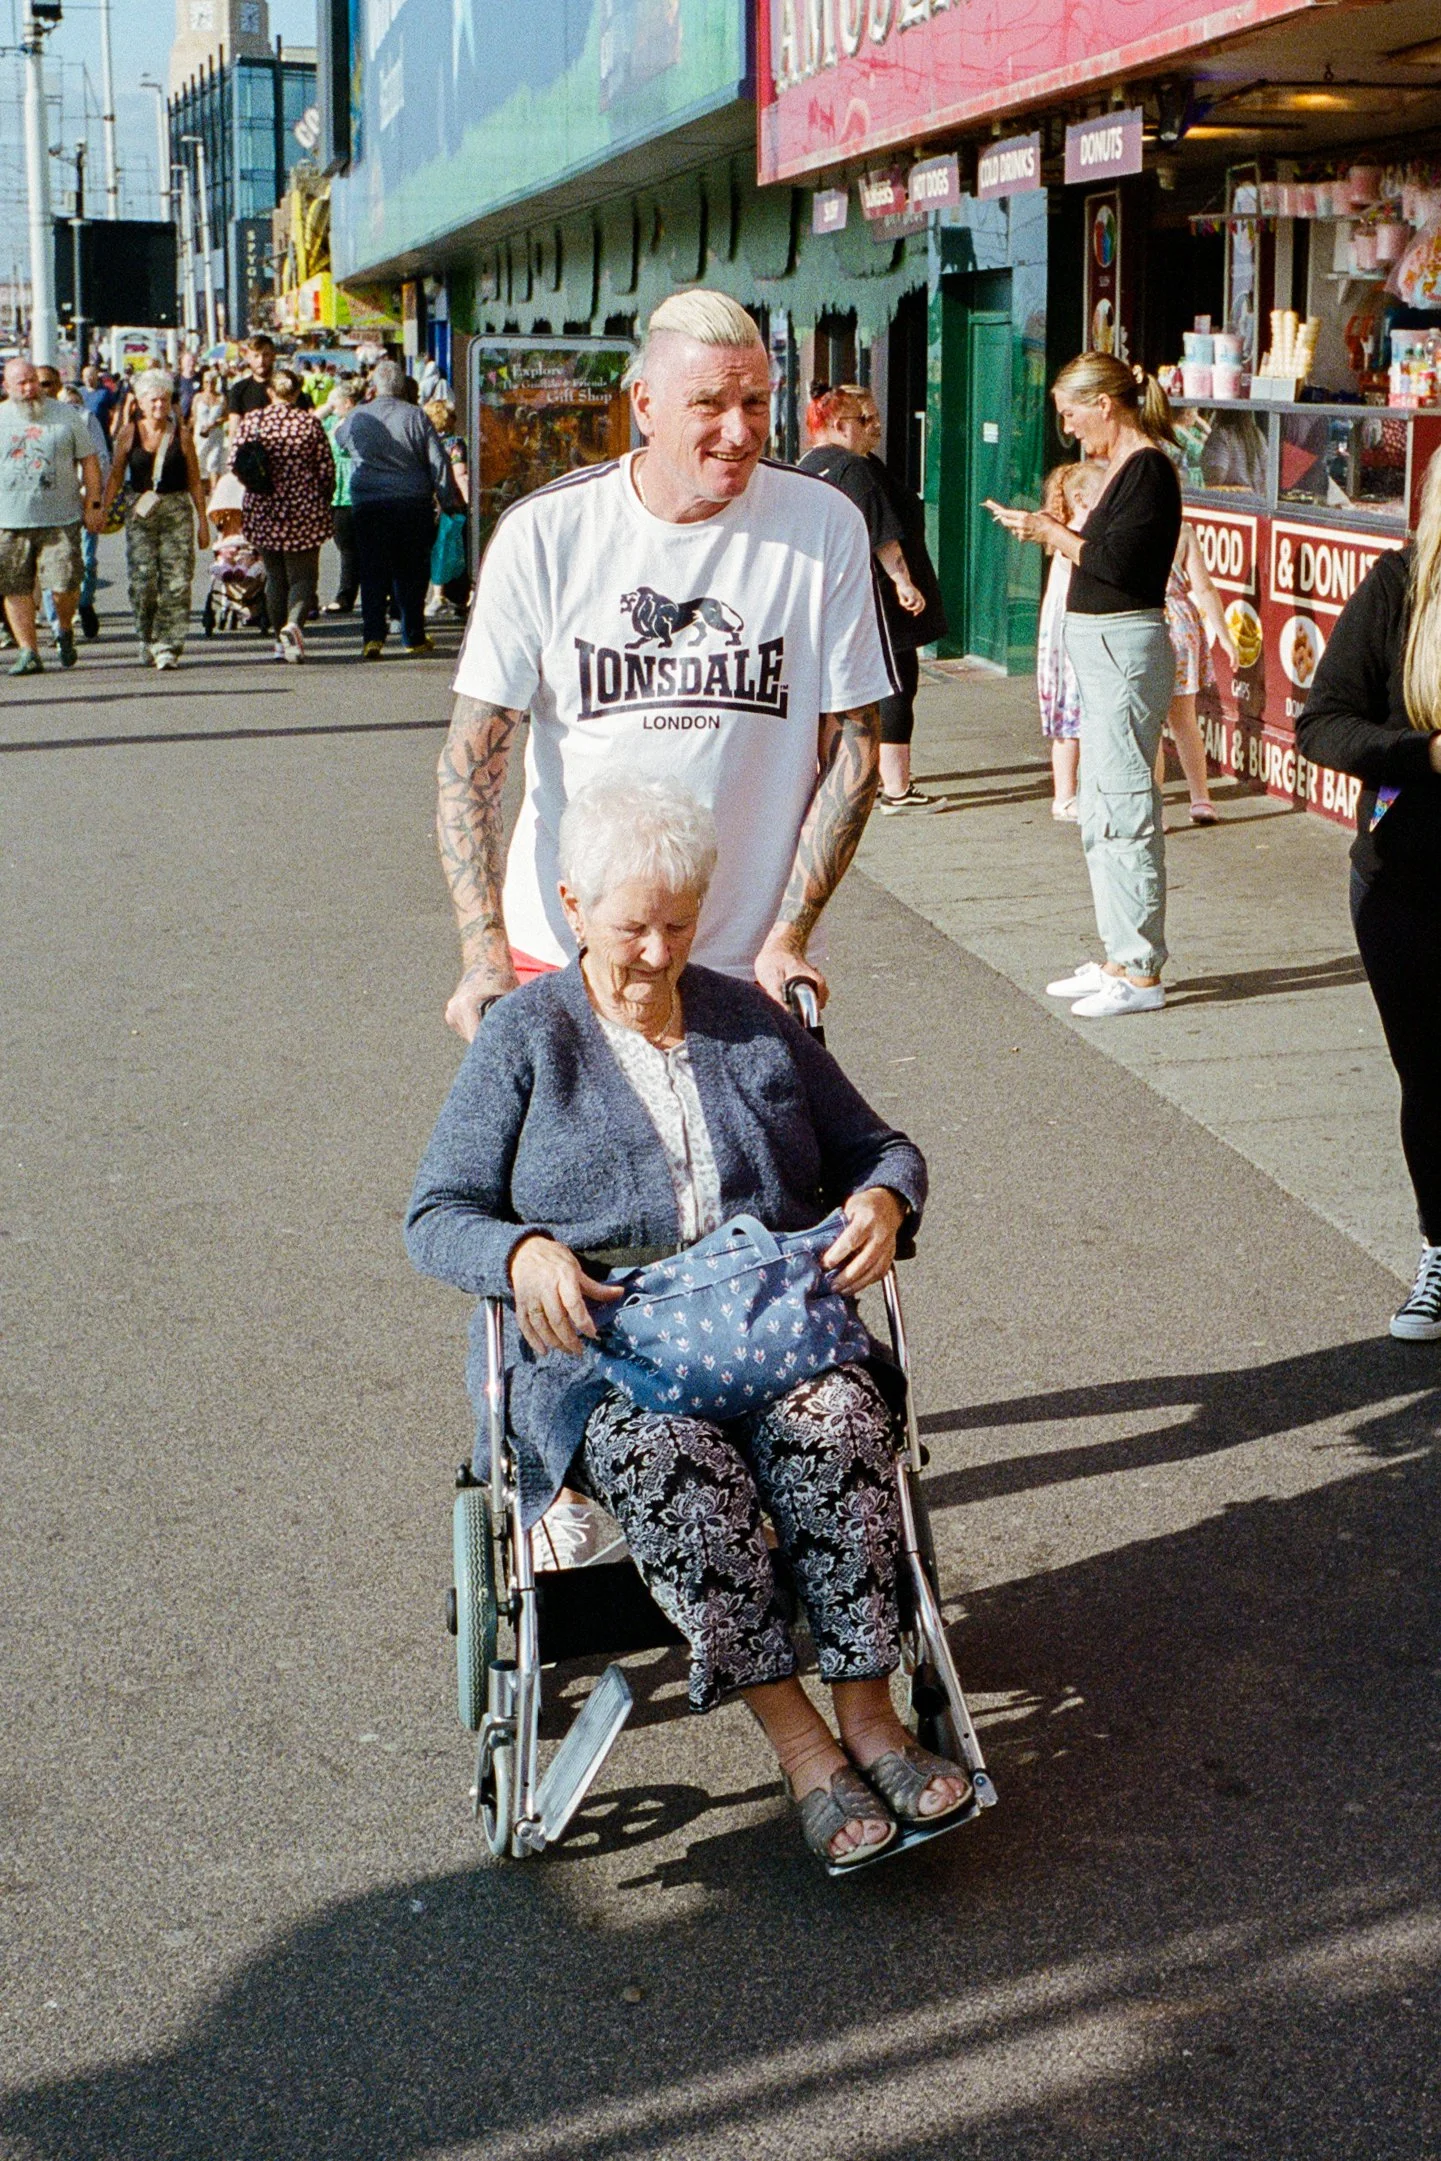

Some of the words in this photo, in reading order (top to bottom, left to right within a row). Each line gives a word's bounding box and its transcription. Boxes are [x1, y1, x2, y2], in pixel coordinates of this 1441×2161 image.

[1080, 126, 1123, 166] DONUTS
[927, 167, 950, 198] DOGS
[981, 154, 999, 189] COLD
[1000, 147, 1035, 183] DRINKS
[512, 361, 564, 379] Explore
[546, 387, 574, 402] Gift
[578, 387, 612, 404] Shop
[1277, 537, 1295, 590] &
[574, 636, 789, 722] LONSDALE
[643, 715, 720, 730] LONDON
[1230, 729, 1244, 772] &
[1249, 736, 1318, 804] BURGER
[1322, 768, 1364, 820] BAR
